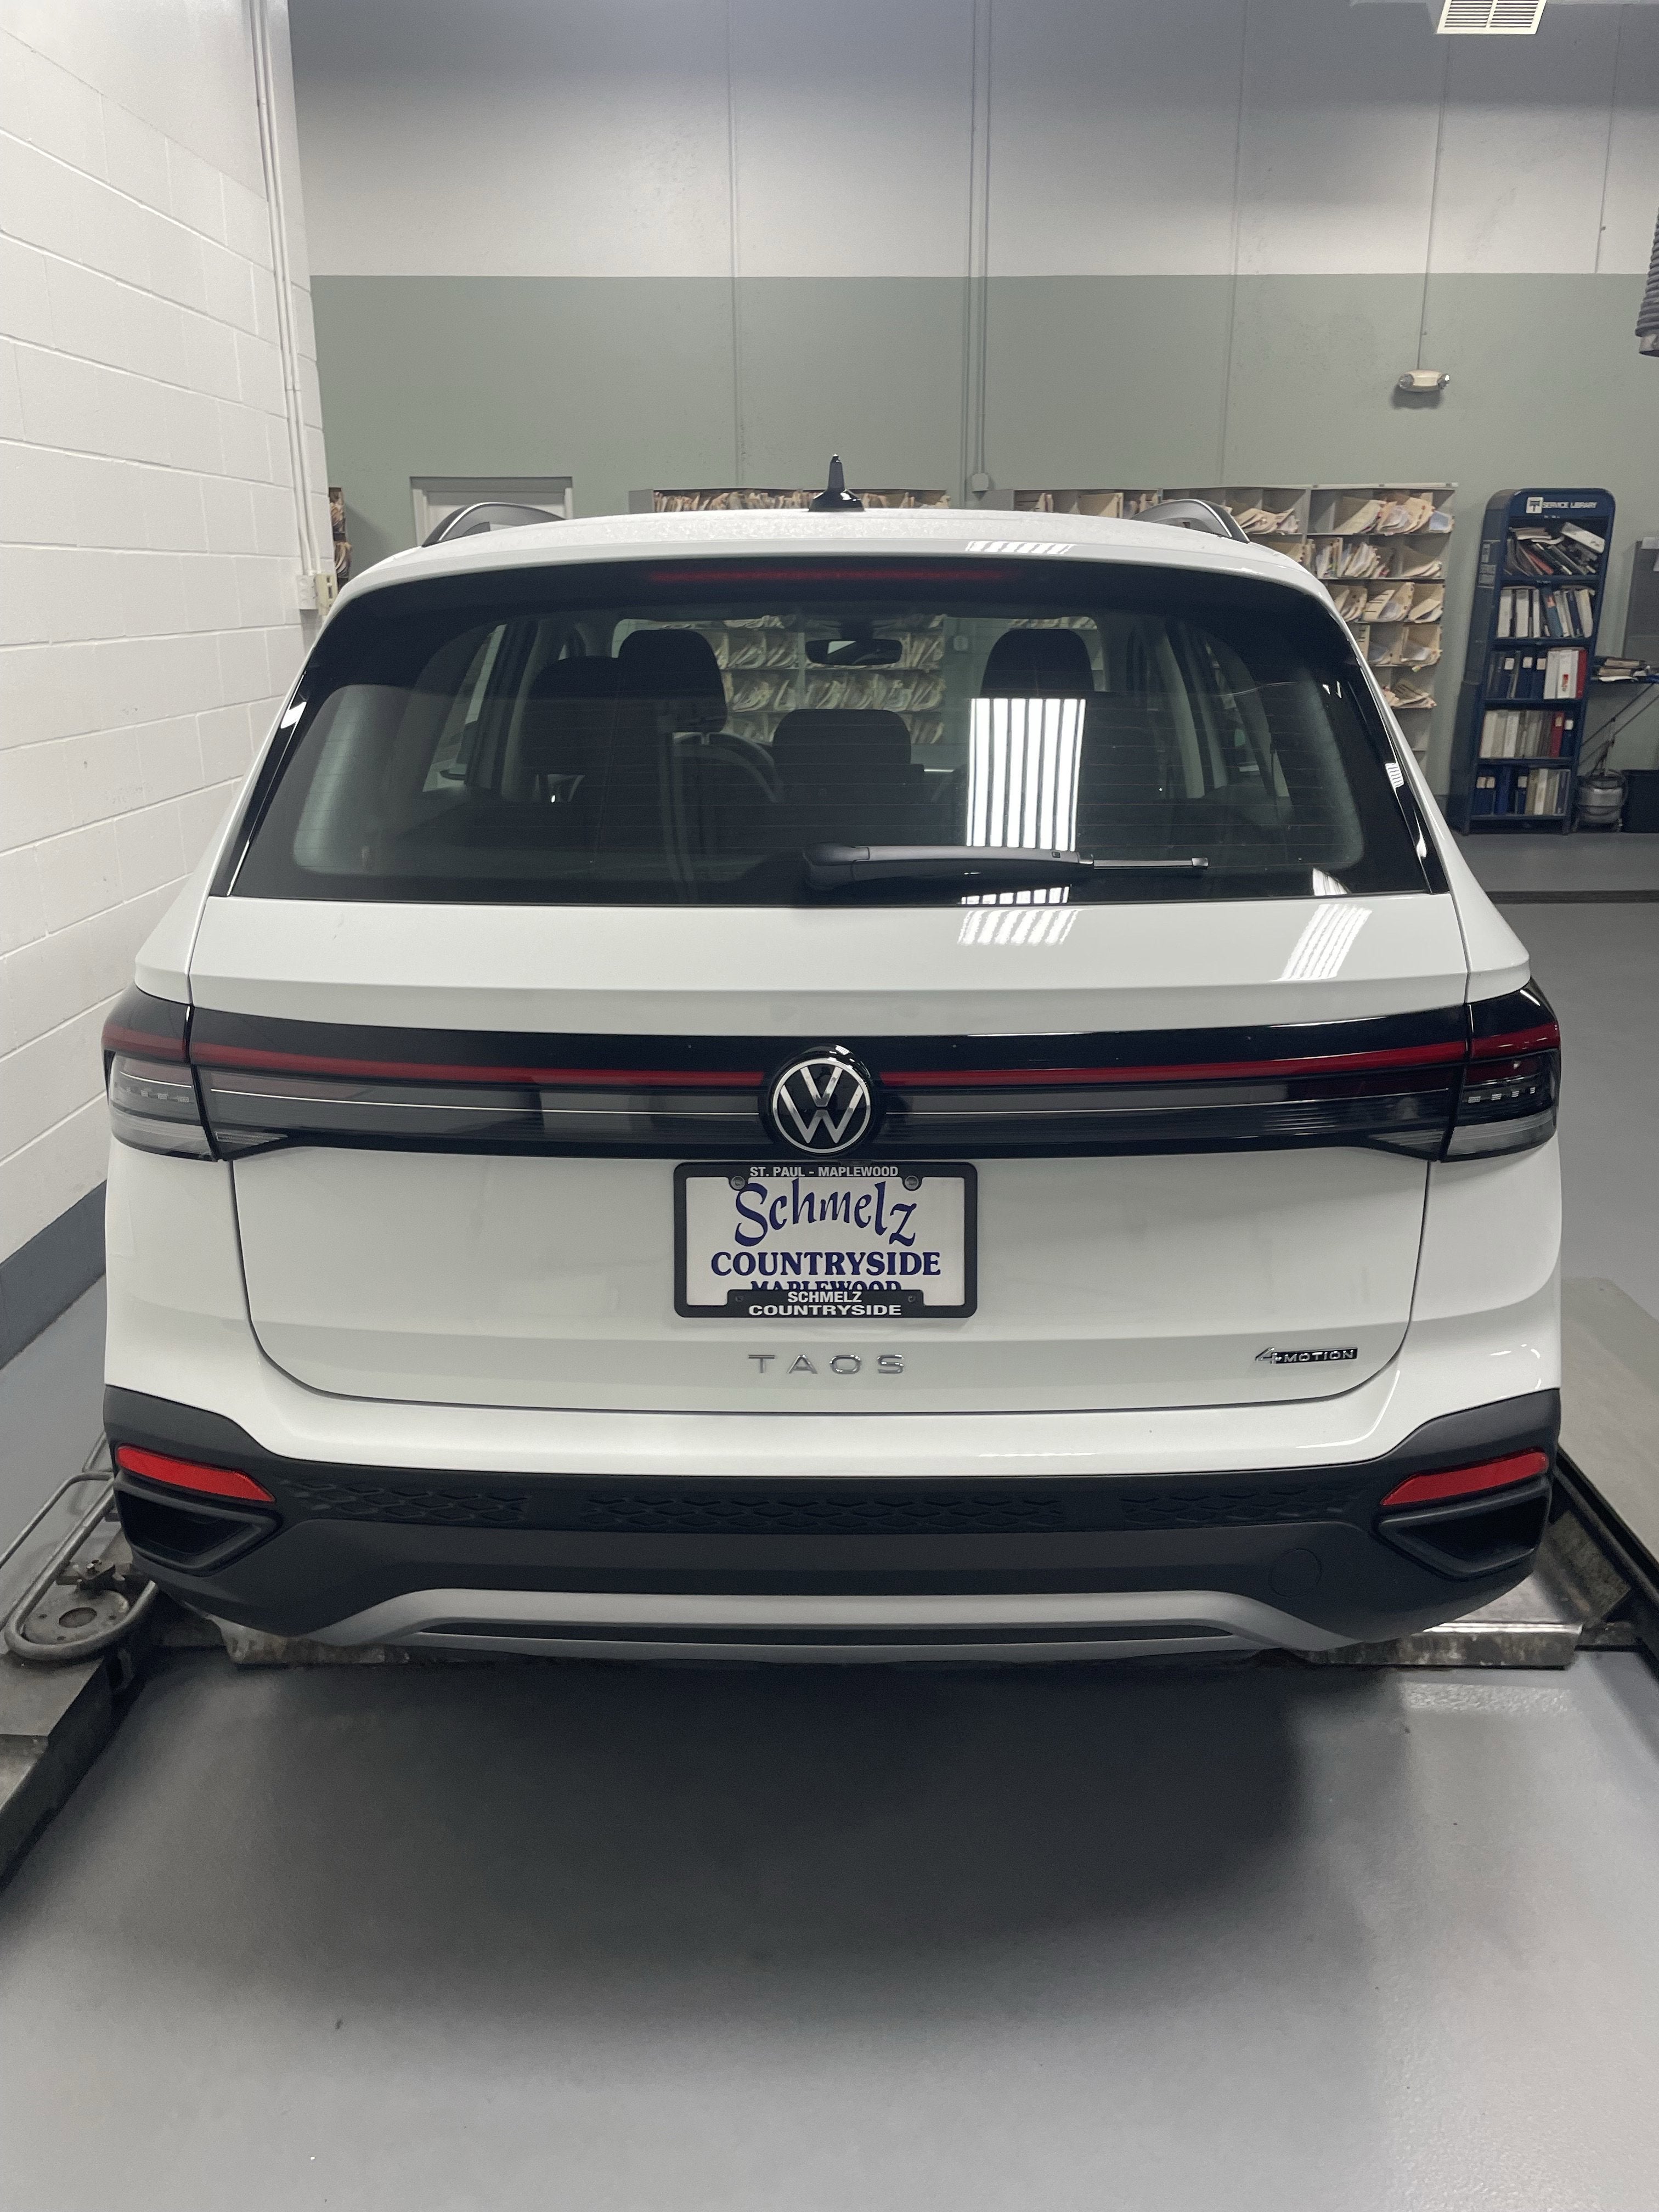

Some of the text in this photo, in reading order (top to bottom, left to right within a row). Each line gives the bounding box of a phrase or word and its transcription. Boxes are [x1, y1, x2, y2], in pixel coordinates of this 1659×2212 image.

[749, 1166, 769, 1177] ST.
[773, 1166, 805, 1177] PAUL
[818, 1166, 899, 1177] MAPLEWOOD
[735, 1178, 917, 1247] Schmelz
[711, 1251, 941, 1276] COUNTRYSIDE
[787, 1291, 862, 1303] SCHMELZ
[748, 1305, 902, 1316] COUNTRYSIDE
[748, 1354, 905, 1374] TAOS
[1255, 1347, 1355, 1364] 4MOTION
